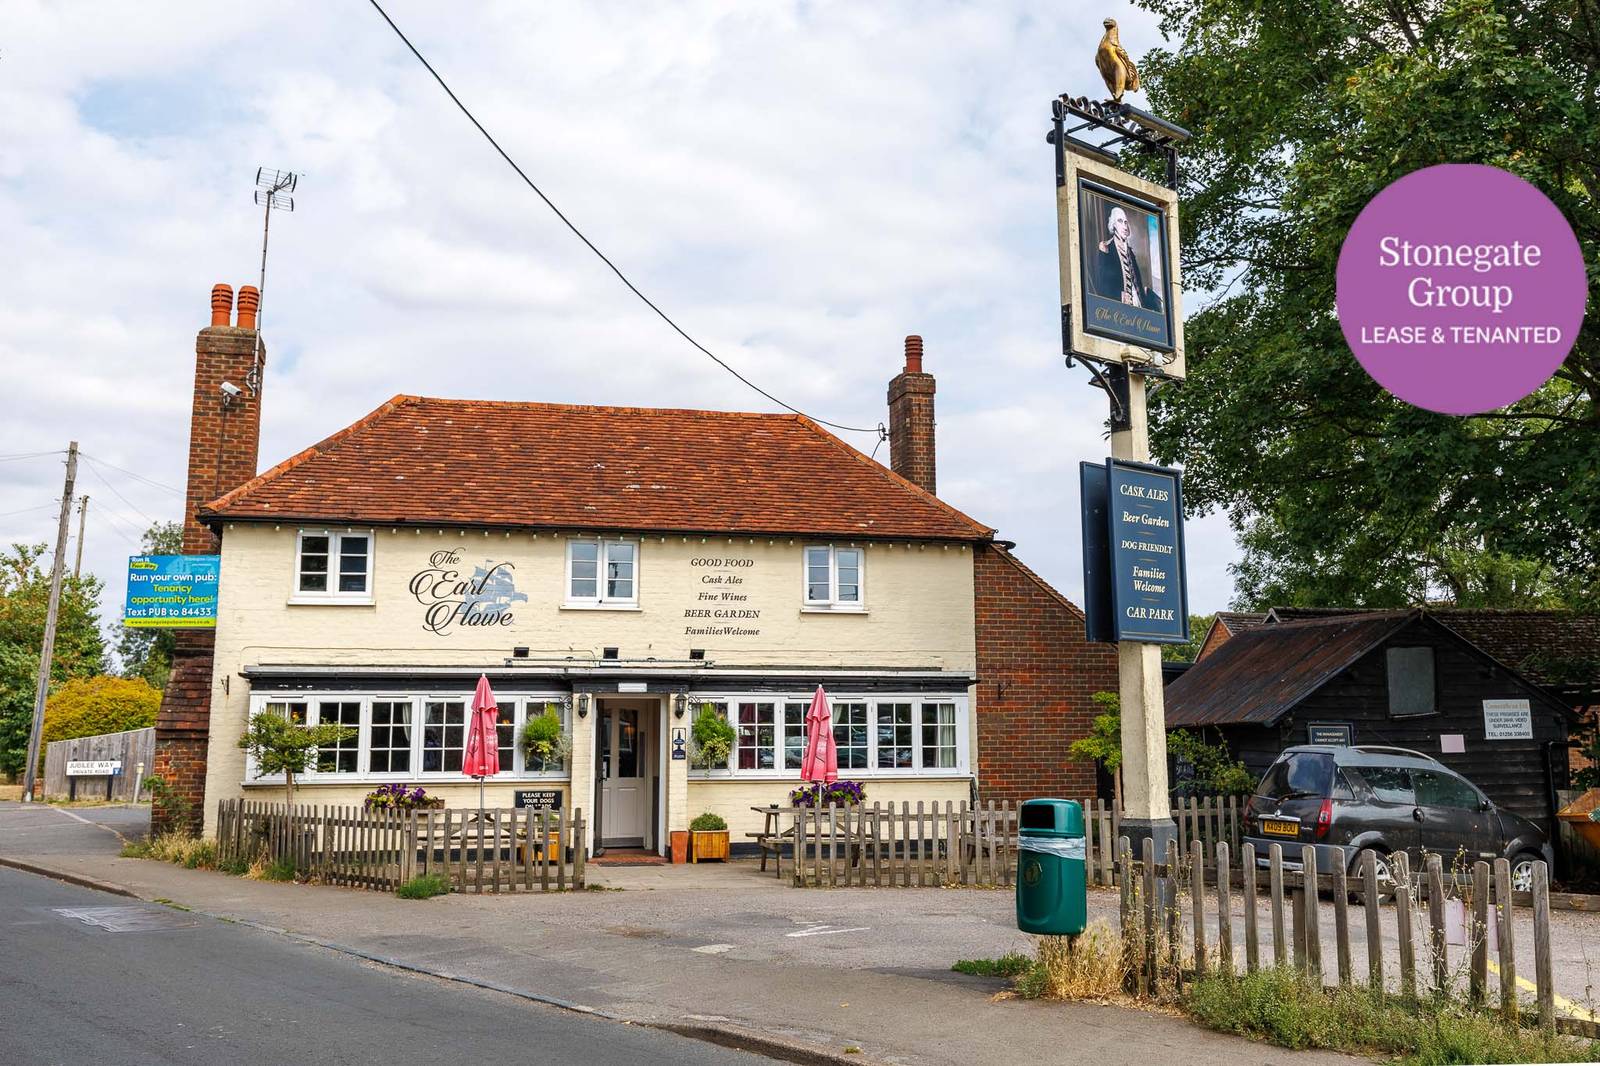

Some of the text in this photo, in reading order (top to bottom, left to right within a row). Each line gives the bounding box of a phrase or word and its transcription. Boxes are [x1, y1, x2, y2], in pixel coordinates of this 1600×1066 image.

[1095, 306, 1112, 320] The
[1120, 484, 1169, 502] CASK ALES
[1122, 511, 1169, 528] Beer Garden
[1121, 540, 1173, 554] DOG FRIENDLY
[428, 547, 466, 569] The
[691, 558, 754, 567] GOOD FOOD
[130, 573, 148, 581] Run
[150, 574, 171, 583] your
[195, 573, 217, 583] pub:
[1132, 566, 1166, 579] Families
[409, 563, 516, 606] Earl
[701, 575, 743, 584] Cask Ales
[153, 584, 192, 593] Tenancy
[1134, 580, 1166, 593] Welcome
[131, 595, 213, 605] opportunity here!
[697, 592, 747, 601] Fine Wines
[127, 607, 212, 616] Text PUB to 84433
[422, 600, 514, 636] Howe
[683, 609, 760, 618] BEER GARDEN
[1126, 606, 1174, 621] CAR PARK
